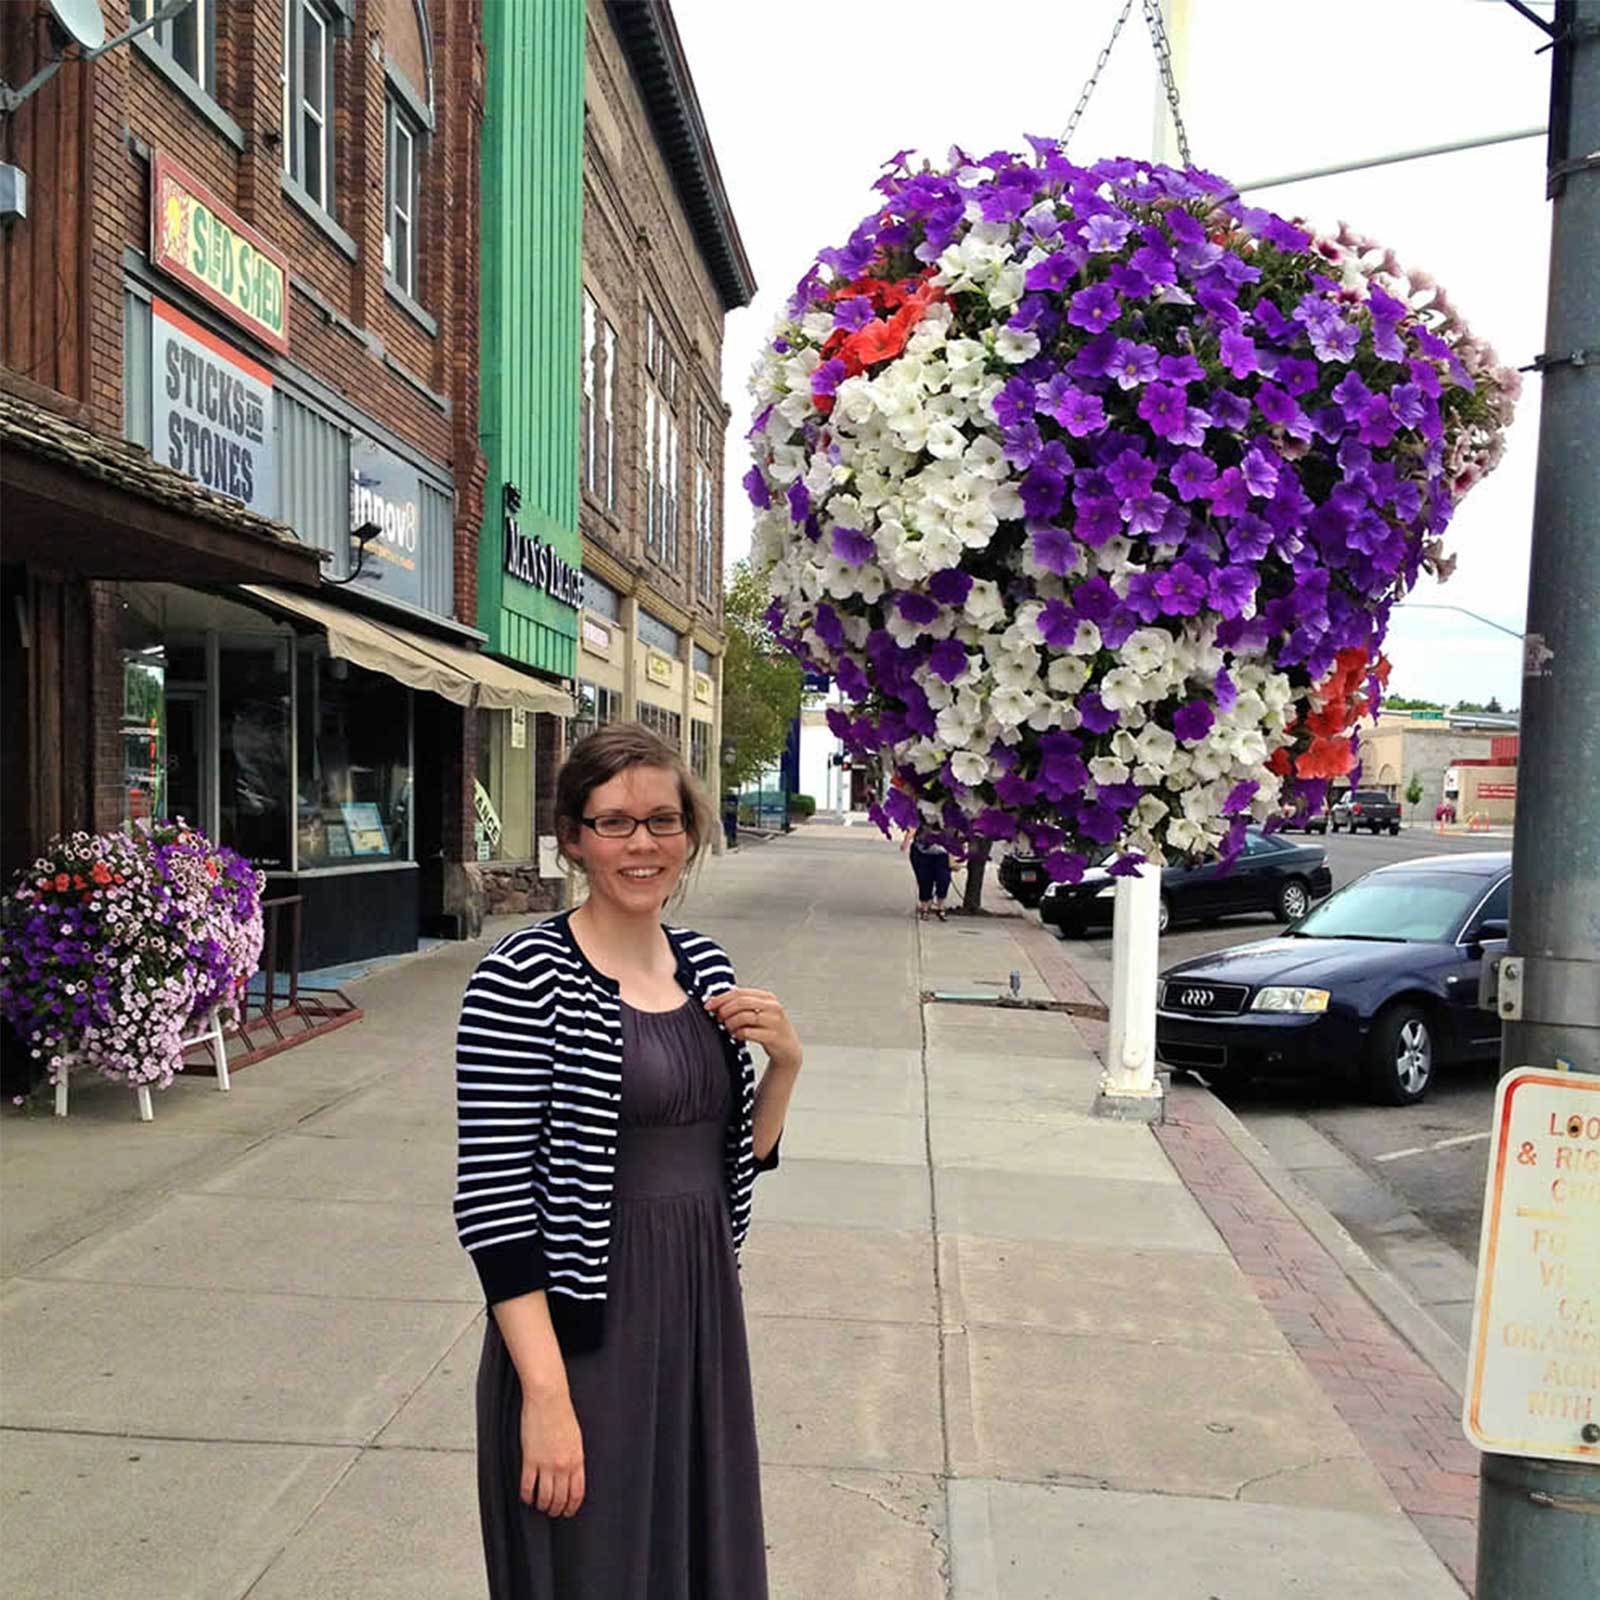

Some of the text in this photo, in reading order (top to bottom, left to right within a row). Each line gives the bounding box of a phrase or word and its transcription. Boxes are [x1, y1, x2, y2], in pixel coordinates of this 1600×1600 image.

[239, 244, 282, 332] SHED
[165, 338, 246, 438] STICKS
[168, 410, 254, 504] STONES
[1517, 1141, 1537, 1166] &
